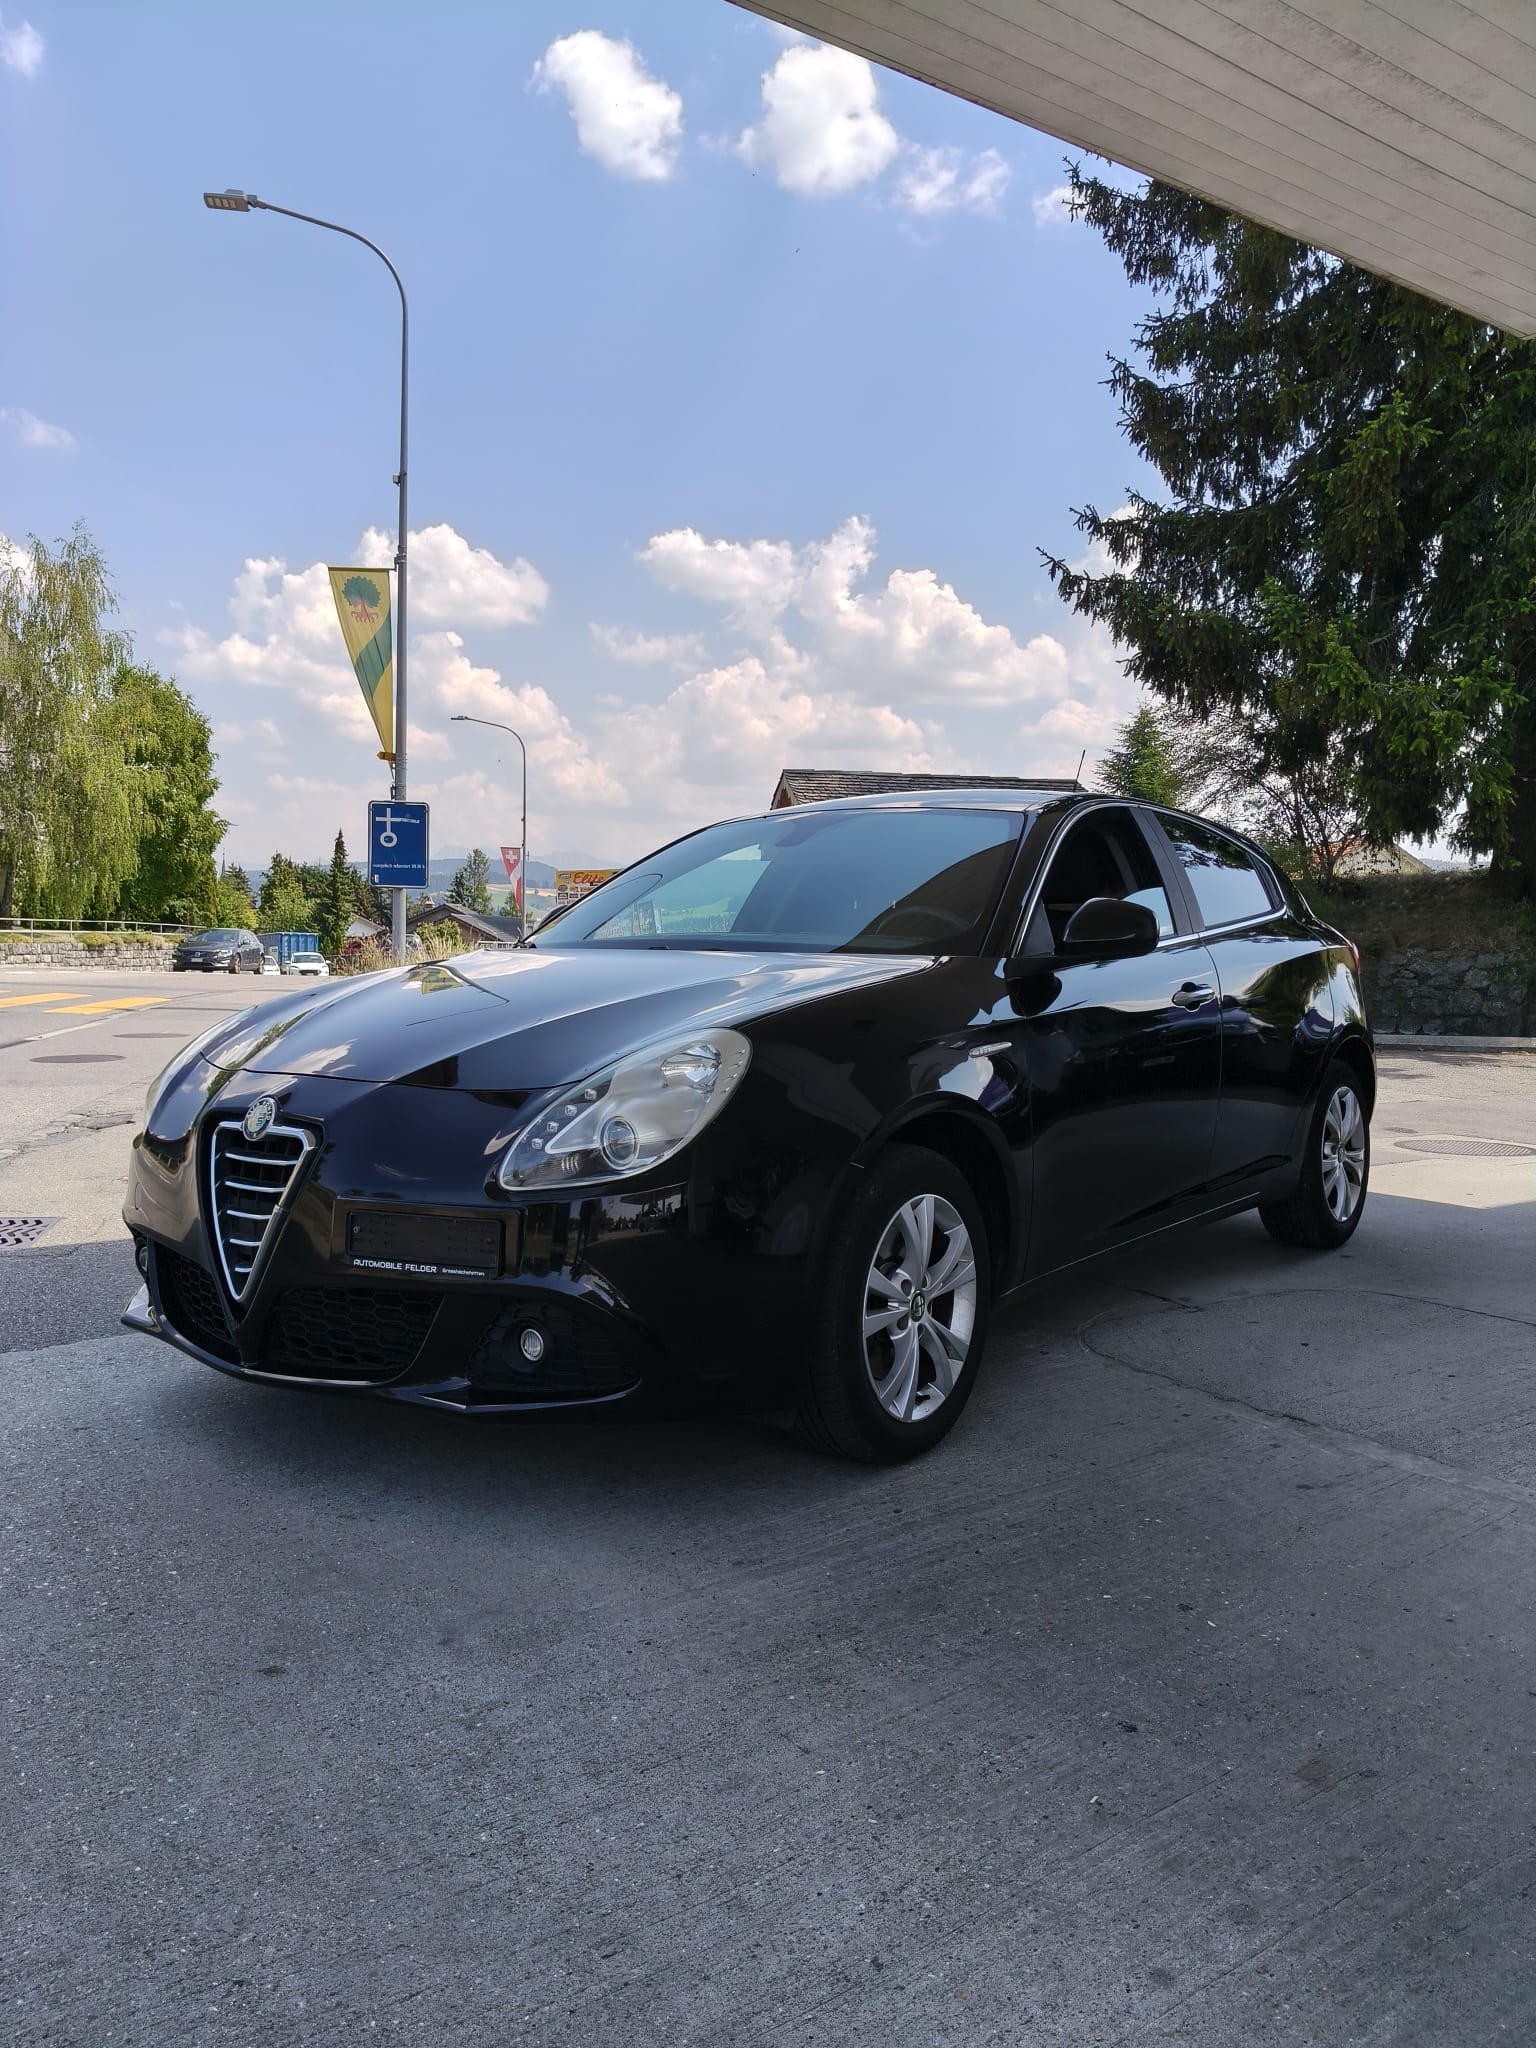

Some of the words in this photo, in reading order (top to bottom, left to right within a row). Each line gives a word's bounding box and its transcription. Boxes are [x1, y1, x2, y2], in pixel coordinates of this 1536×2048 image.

[573, 872, 605, 884] Elite
[353, 1259, 402, 1270] AUTOMOBILE
[405, 1263, 437, 1273] FELDER
